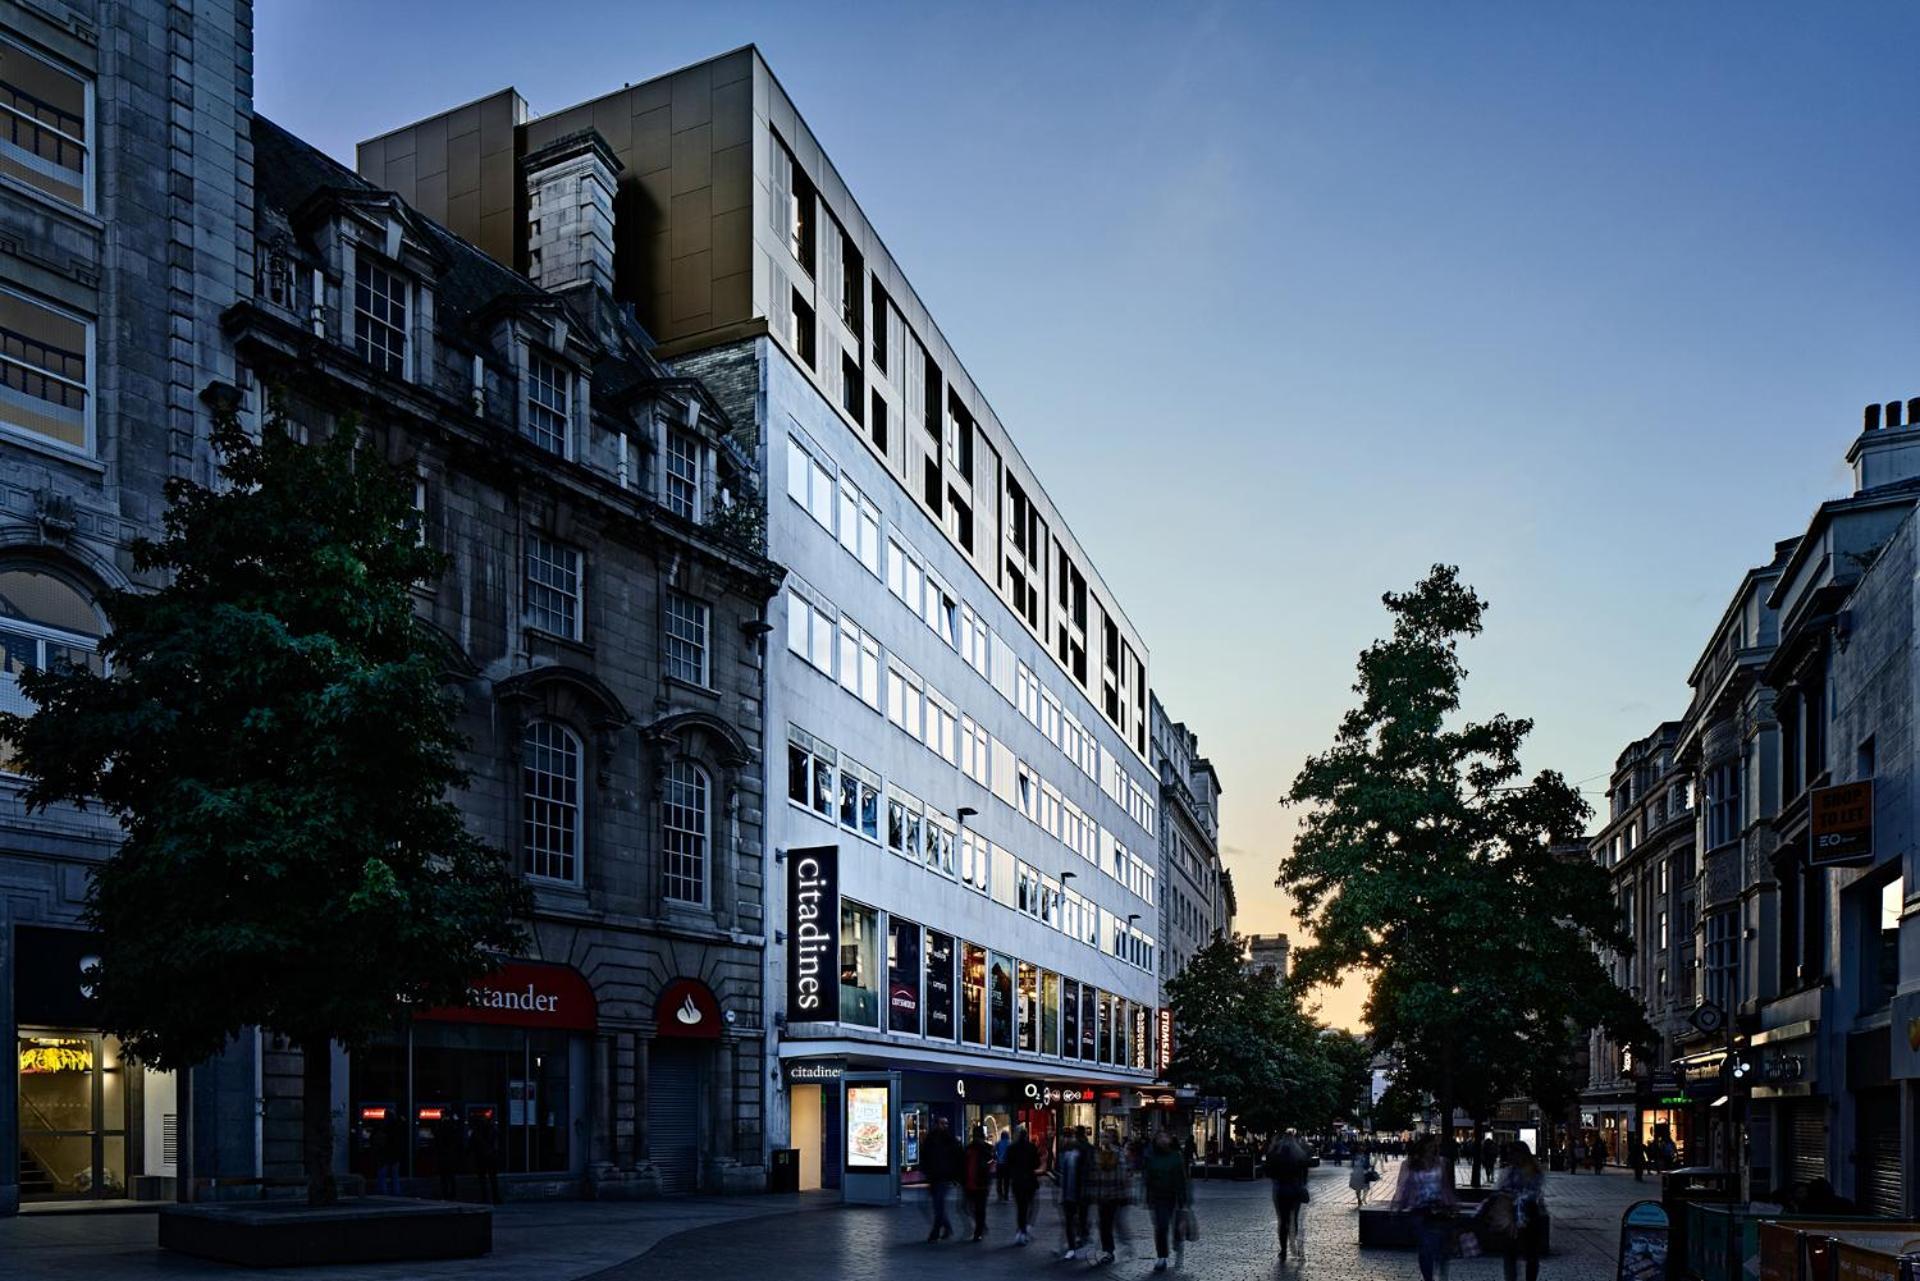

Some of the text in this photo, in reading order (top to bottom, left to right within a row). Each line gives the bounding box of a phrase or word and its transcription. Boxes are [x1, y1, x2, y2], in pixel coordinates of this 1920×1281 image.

[1820, 810, 1839, 828] TO
[798, 858, 831, 1009] citadines
[465, 983, 560, 1012] tander
